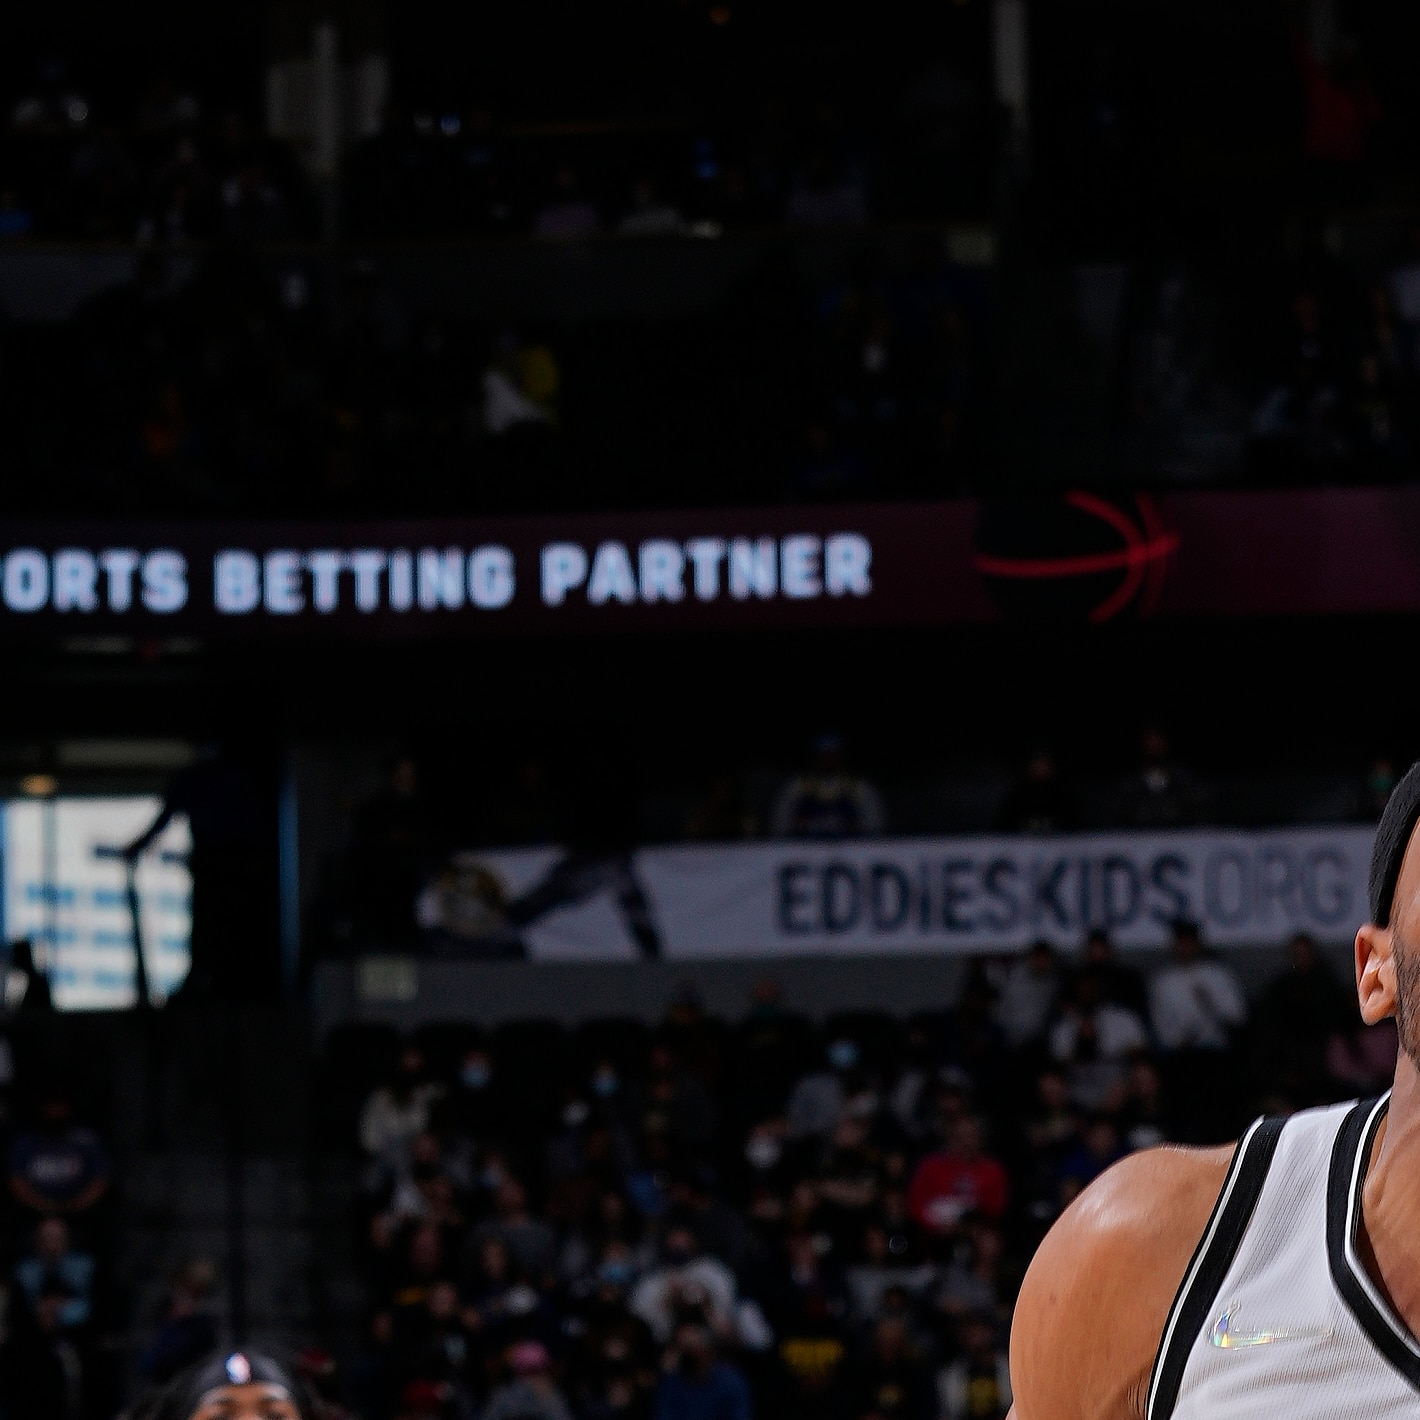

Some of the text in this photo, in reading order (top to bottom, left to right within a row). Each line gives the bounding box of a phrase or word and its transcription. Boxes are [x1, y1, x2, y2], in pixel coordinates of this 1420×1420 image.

[0, 533, 873, 613] ORTS BETTING PARTNER
[774, 843, 1353, 937] EDDIESKIDSORG
